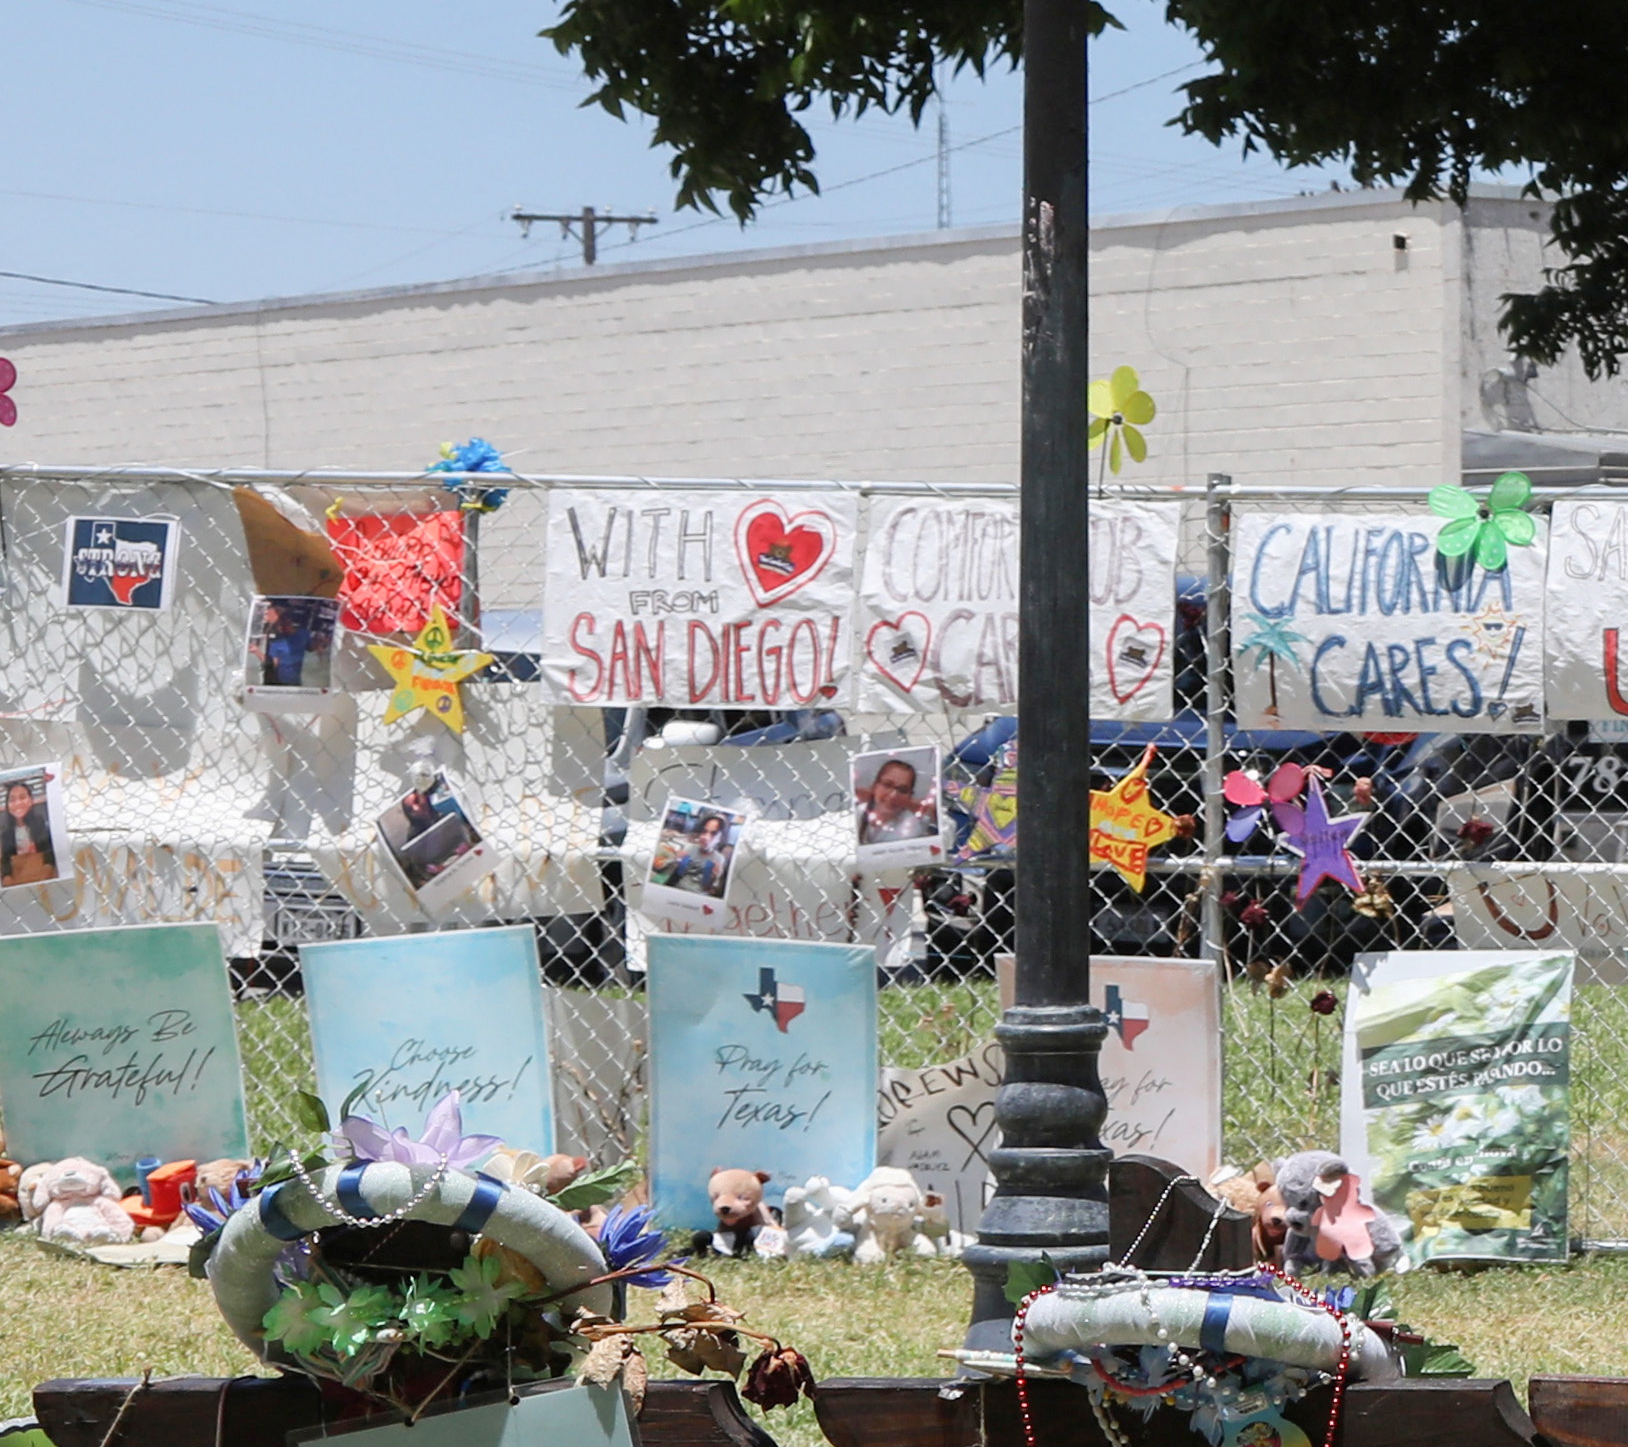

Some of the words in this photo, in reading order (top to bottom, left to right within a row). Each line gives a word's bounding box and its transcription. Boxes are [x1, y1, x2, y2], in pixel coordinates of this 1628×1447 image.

[566, 505, 714, 582] WITH
[881, 506, 1019, 603] COMFOR
[629, 589, 720, 615] FROM
[567, 611, 665, 703] SAN
[687, 613, 841, 705] DIEGO!
[1310, 625, 1527, 722] CARES!
[27, 1016, 138, 1056] Always
[146, 1009, 198, 1043] Be
[388, 1037, 478, 1074] Choose
[31, 1045, 216, 1106] Grateful!
[714, 1043, 785, 1090] Pray
[784, 1044, 830, 1090] for
[1369, 1059, 1401, 1078] SEA
[1403, 1055, 1427, 1073] LO
[1428, 1050, 1468, 1073] QUE
[1537, 1037, 1564, 1054] LO
[348, 1055, 533, 1115] Kindness!
[1133, 1068, 1174, 1103] for
[1376, 1080, 1414, 1102] QUE
[1415, 1071, 1470, 1094] ESTÉS
[716, 1087, 832, 1131] Texas!
